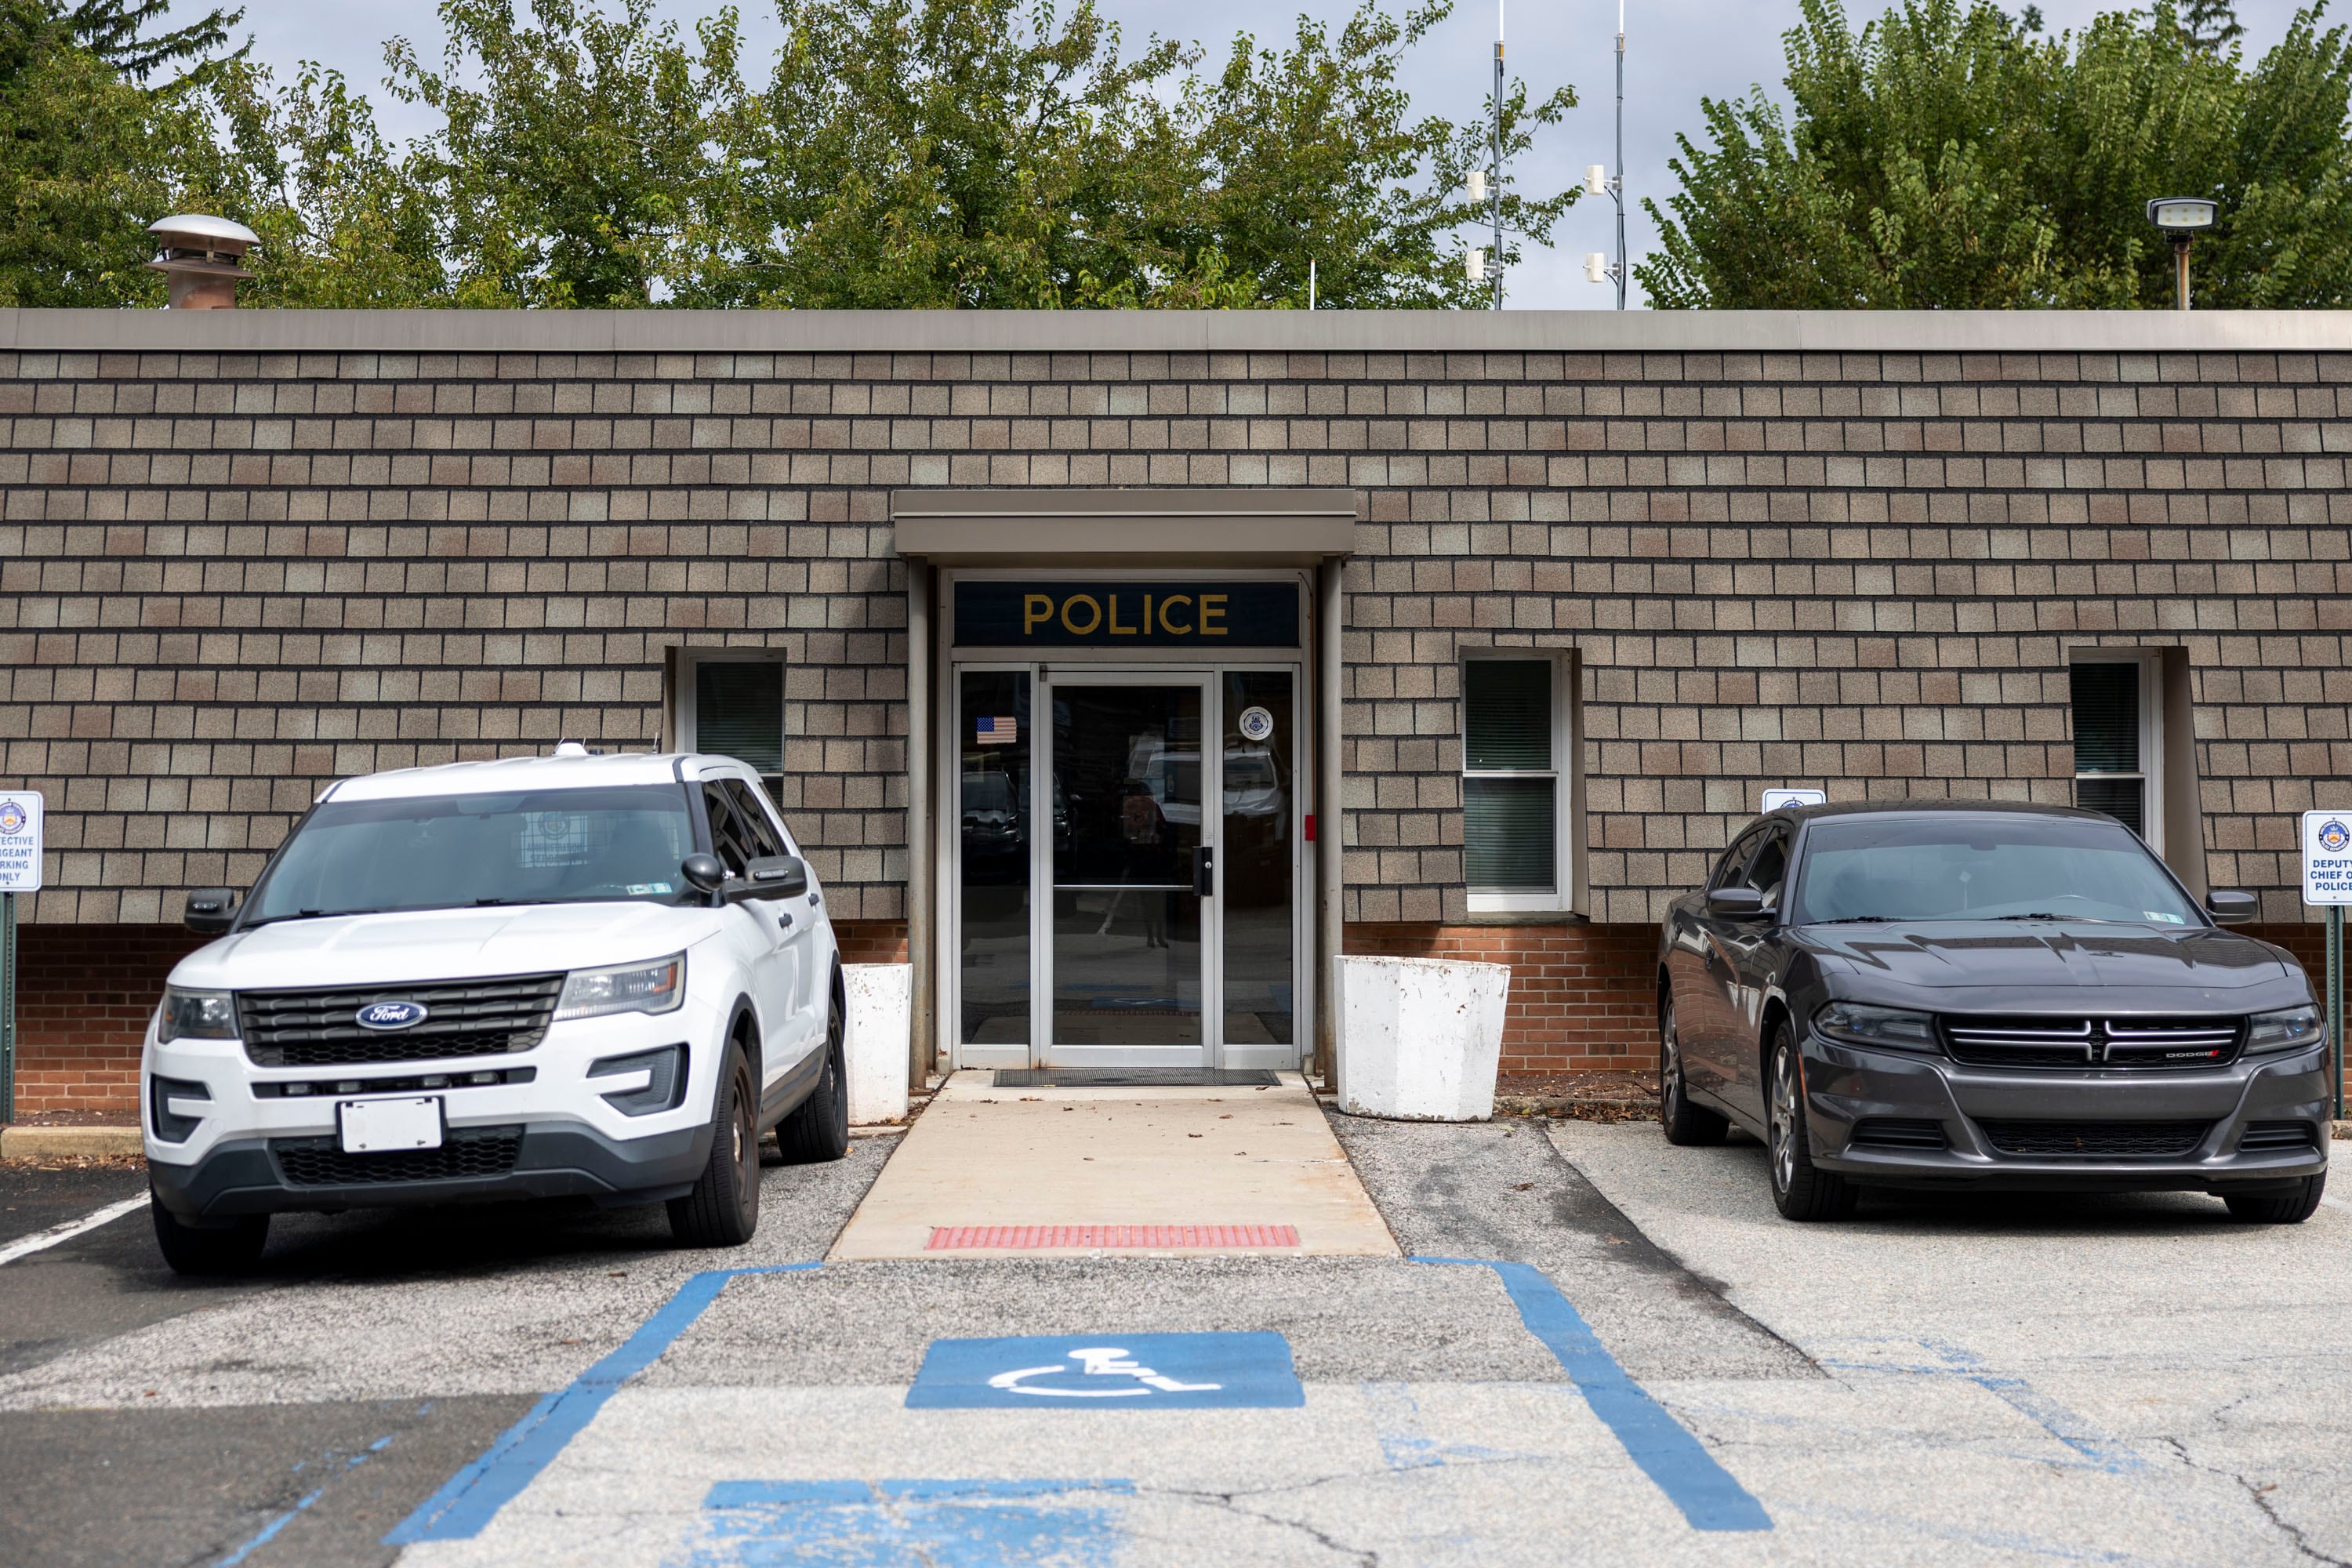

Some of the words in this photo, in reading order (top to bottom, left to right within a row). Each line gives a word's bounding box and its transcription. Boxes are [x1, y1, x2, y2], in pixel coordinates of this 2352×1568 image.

[1024, 594, 1229, 635] POLICE
[0, 837, 34, 845] ECTIVE
[0, 848, 33, 857] GEANT
[2315, 882, 2352, 891] POLICE
[369, 1005, 409, 1022] Ford
